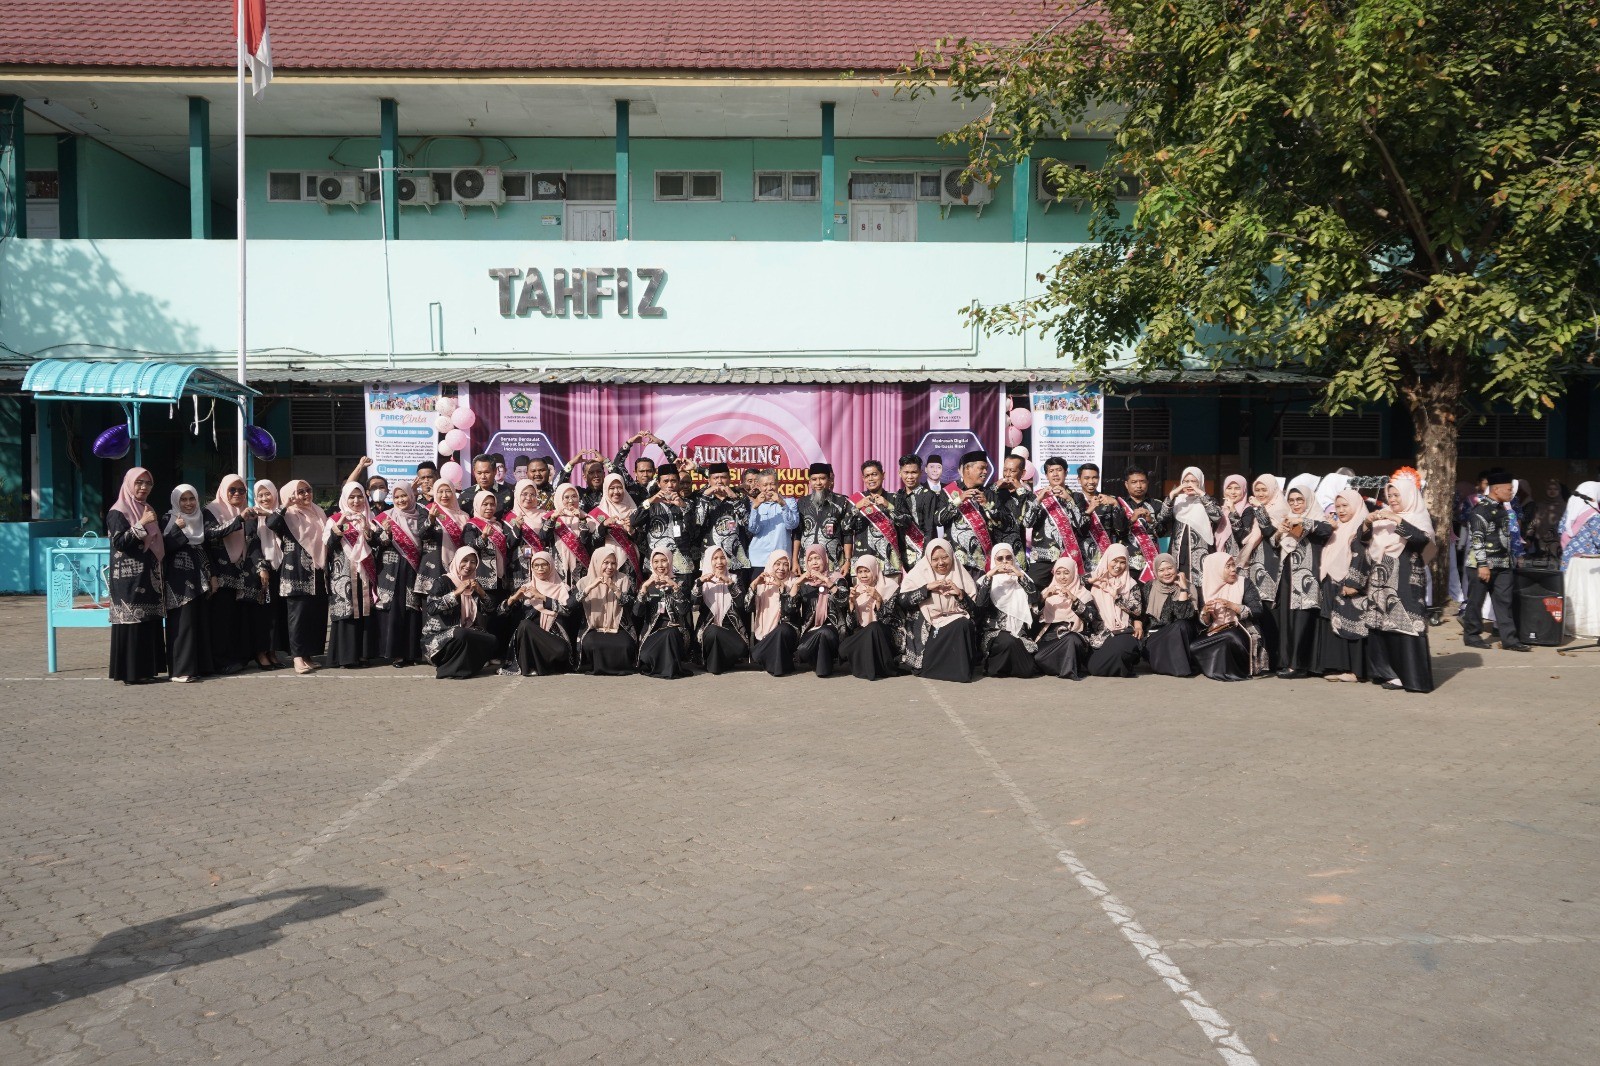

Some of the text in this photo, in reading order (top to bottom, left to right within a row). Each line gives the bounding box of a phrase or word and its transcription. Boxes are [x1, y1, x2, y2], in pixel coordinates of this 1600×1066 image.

[488, 267, 665, 316] TAHFIZ
[402, 413, 427, 424] Cinta
[1044, 413, 1088, 423] Panca Cinta
[681, 444, 781, 466] LAUNCHING
